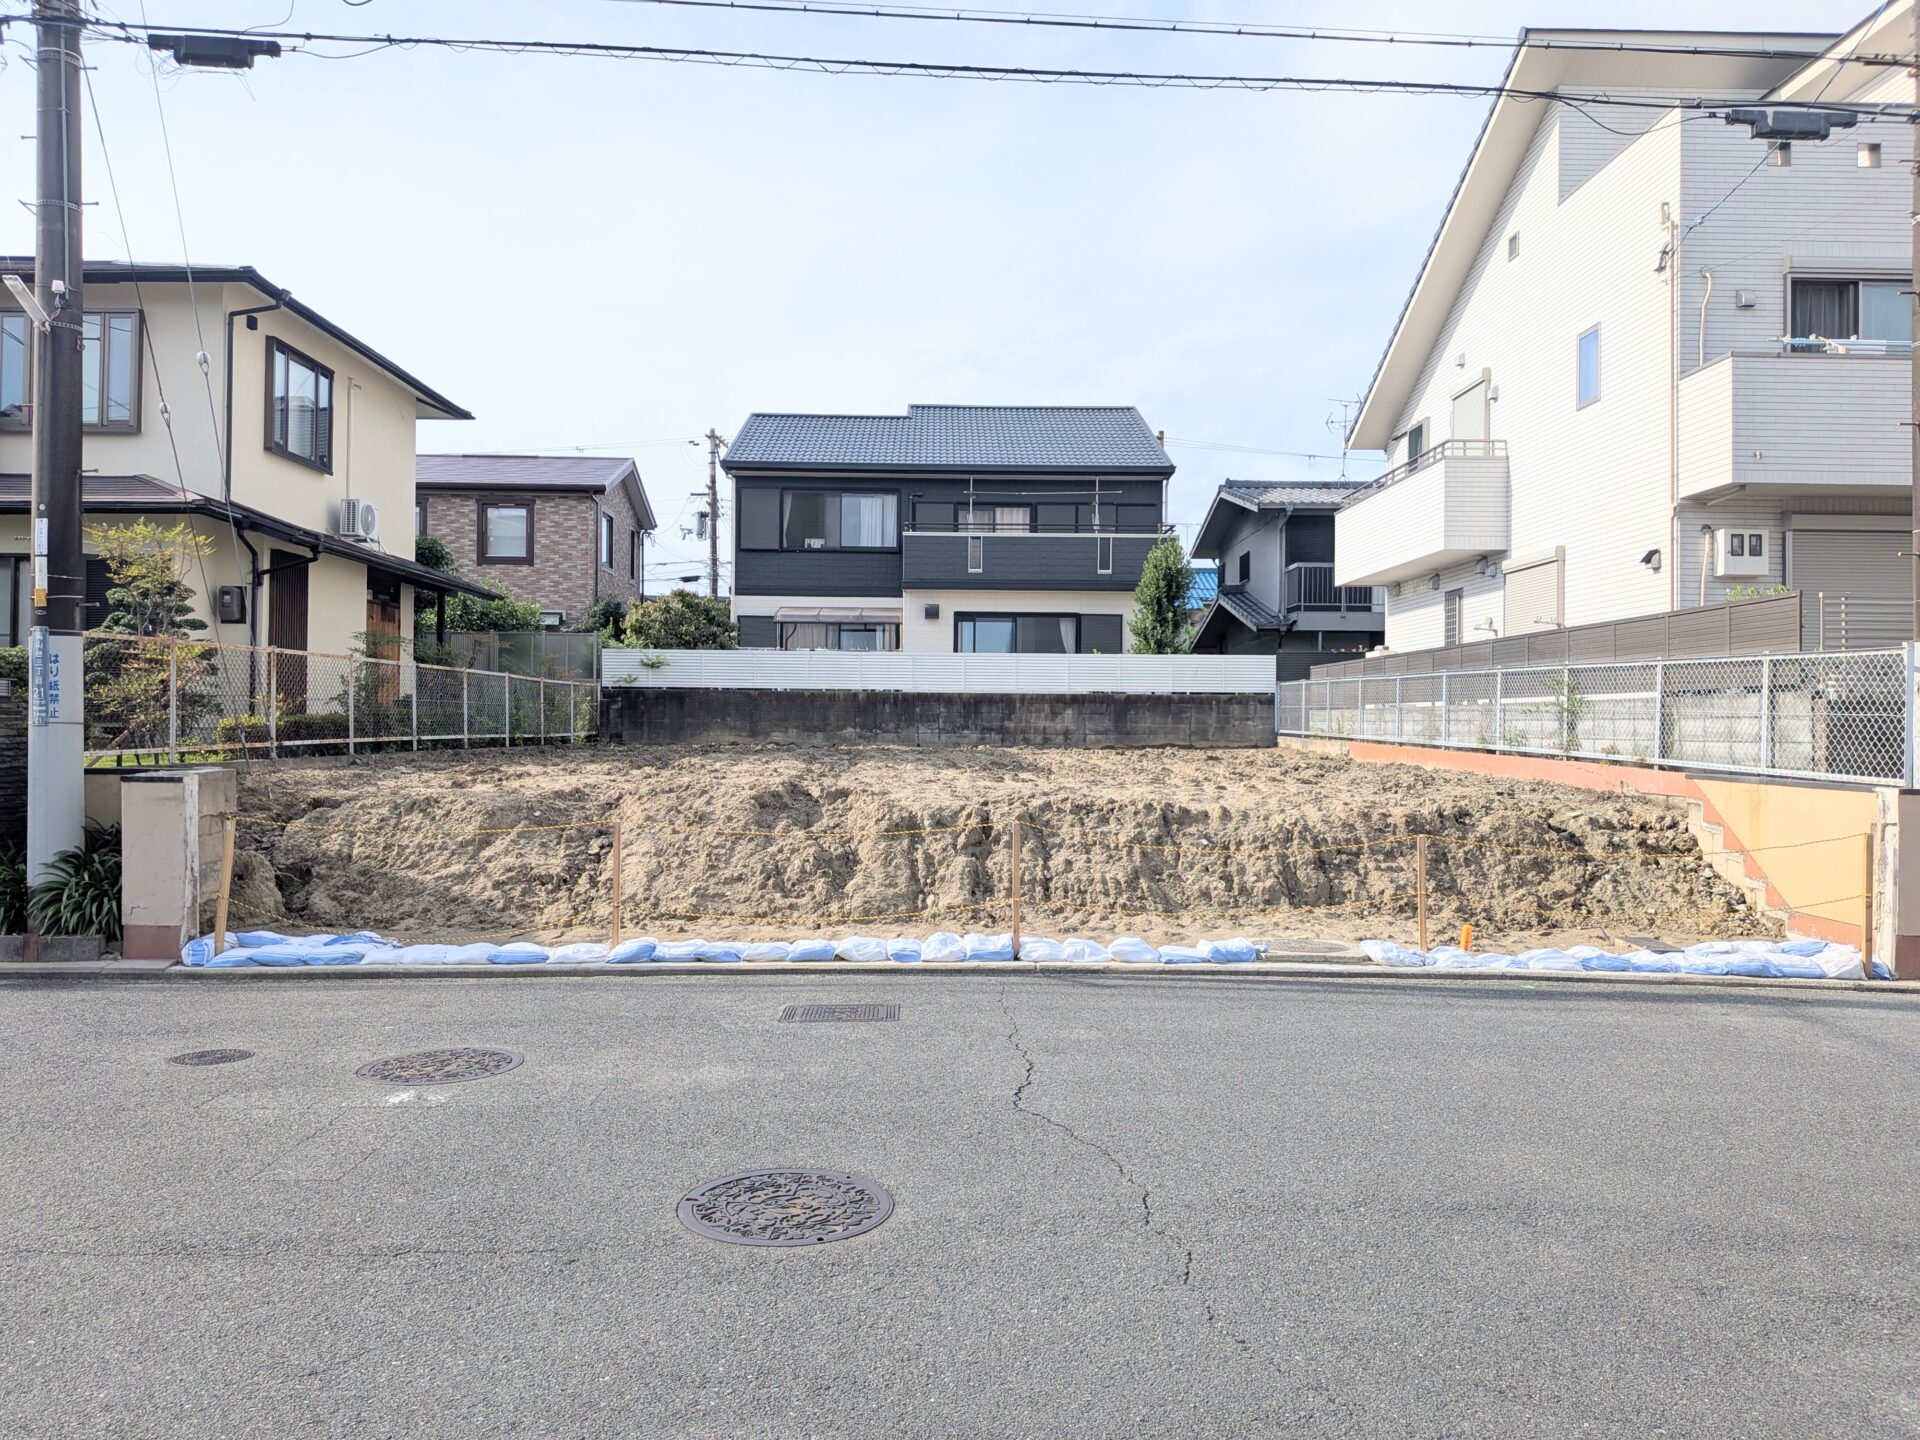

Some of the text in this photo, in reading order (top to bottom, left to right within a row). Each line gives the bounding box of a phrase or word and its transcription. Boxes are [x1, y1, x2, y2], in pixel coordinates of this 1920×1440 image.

[33, 687, 44, 698] 21
[49, 653, 59, 719] はり紙禁止
